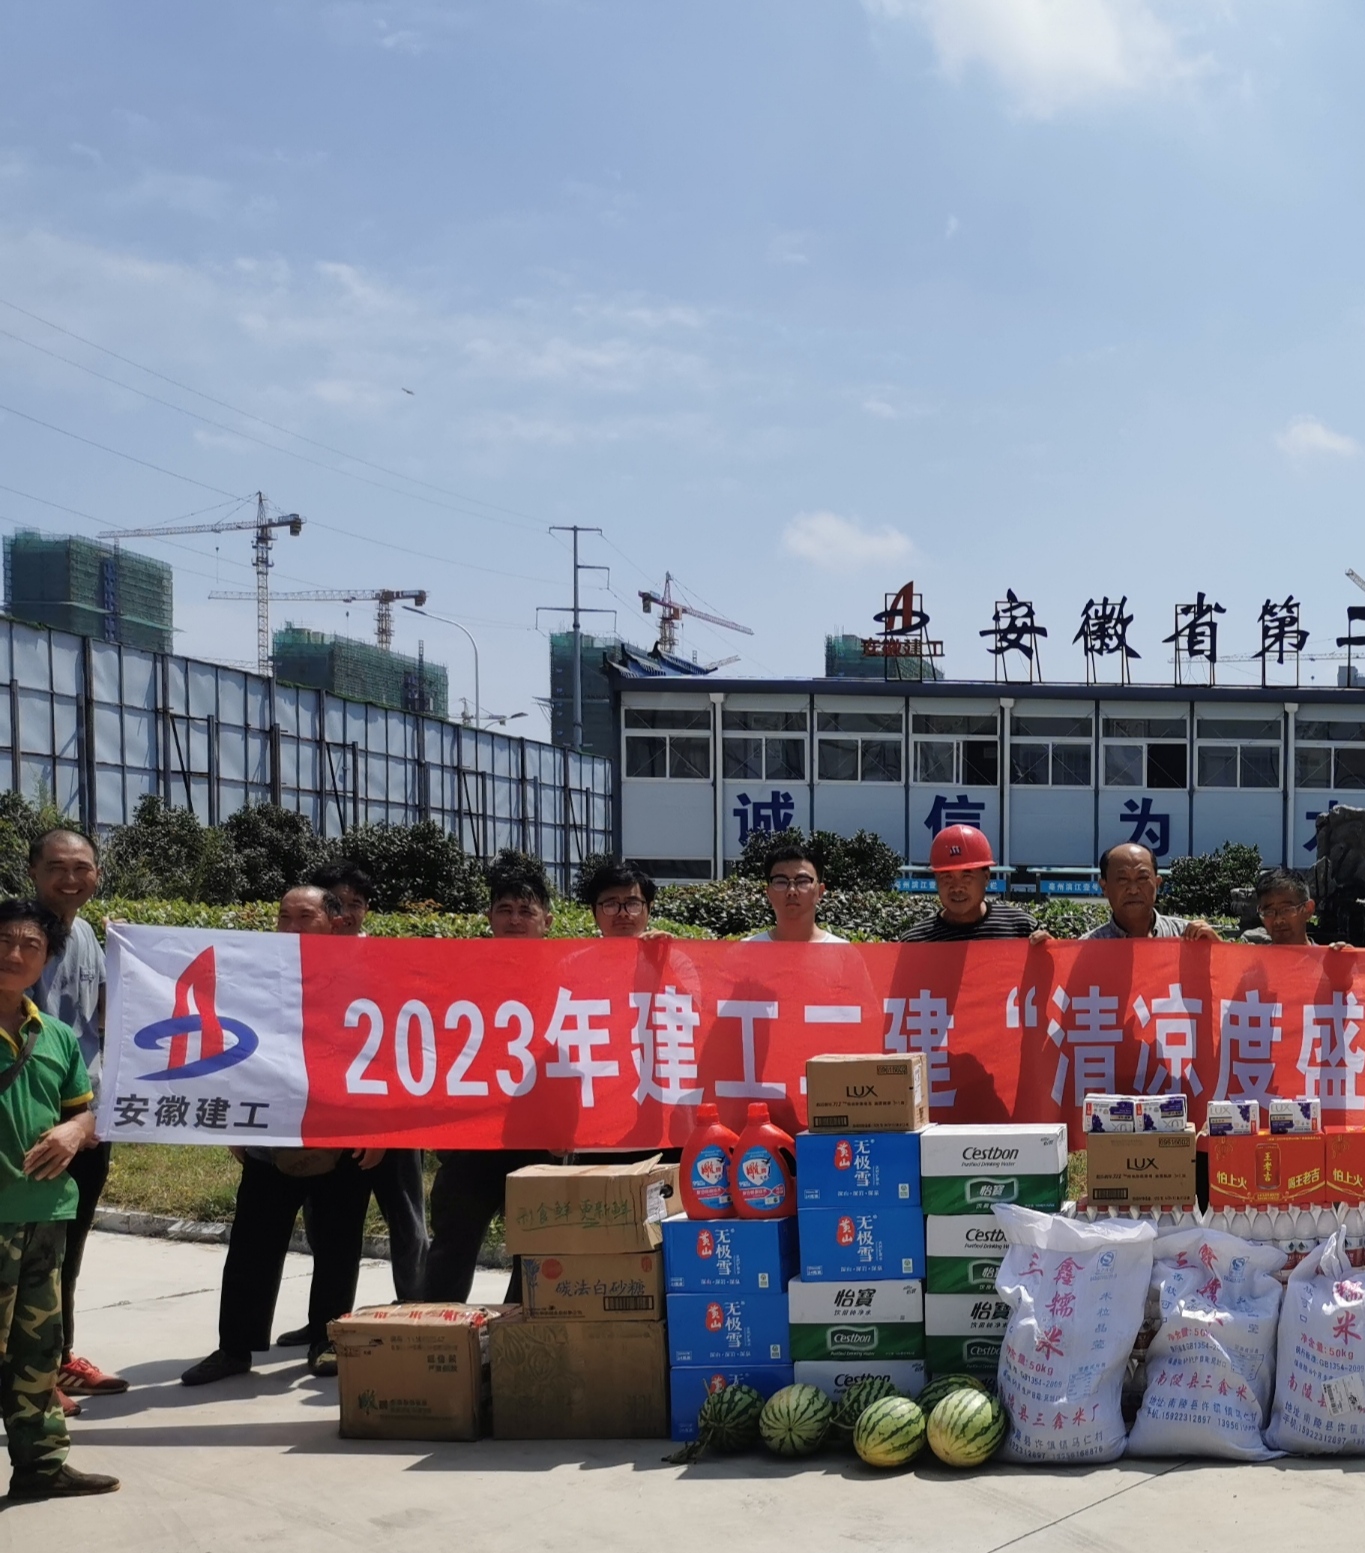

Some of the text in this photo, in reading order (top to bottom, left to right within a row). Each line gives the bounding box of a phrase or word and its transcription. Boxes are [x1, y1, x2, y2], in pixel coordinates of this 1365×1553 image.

[845, 1084, 879, 1099] LUX
[112, 1093, 271, 1132] 安徽建工
[853, 1139, 872, 1188] 无极雪
[1126, 1157, 1159, 1171] LUX
[1287, 1167, 1321, 1190] 喝王老吉
[1332, 1167, 1364, 1189] 怕上火
[1216, 1170, 1248, 1190] 怕上火
[714, 1228, 733, 1276] 无极雪
[856, 1214, 875, 1263] 无极雪
[724, 1301, 743, 1348] 无极雪
